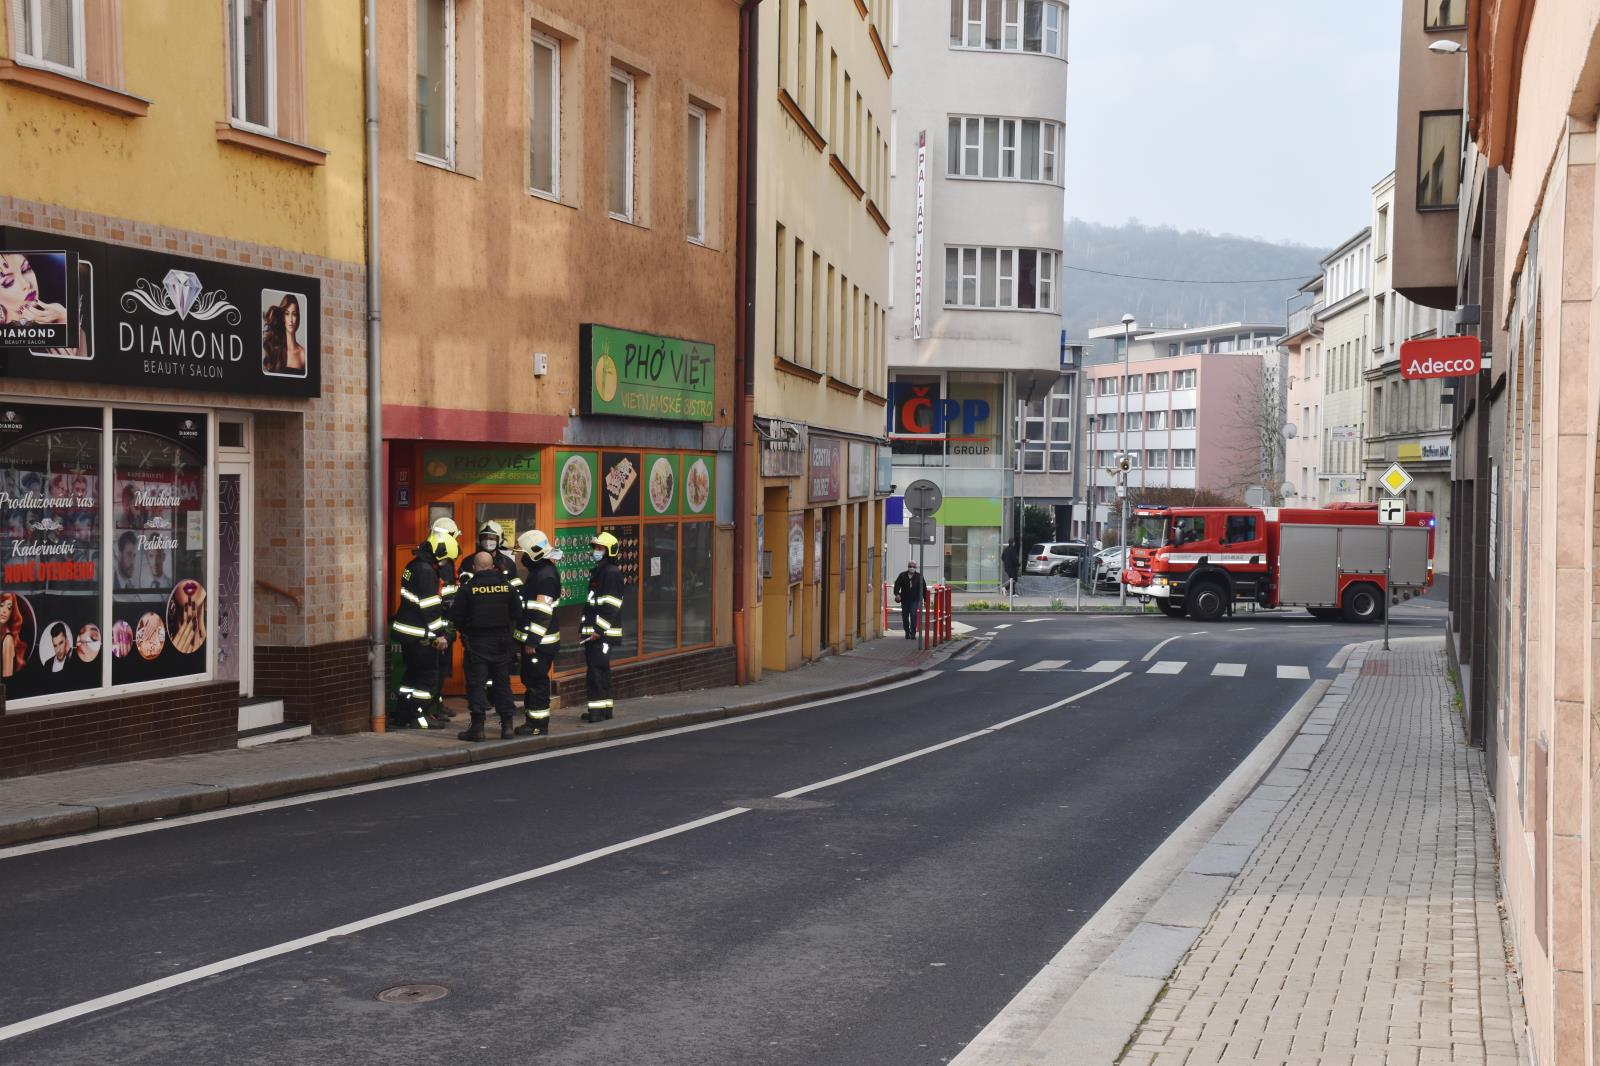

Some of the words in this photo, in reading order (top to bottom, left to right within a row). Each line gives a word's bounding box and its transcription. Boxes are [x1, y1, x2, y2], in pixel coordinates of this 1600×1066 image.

[917, 152, 925, 234] PALÁC
[914, 243, 922, 337] JORDAN
[0, 328, 55, 339] IAMOND
[119, 322, 243, 362] DIAMOND
[143, 359, 186, 376] BEAUTY
[189, 363, 224, 379] SALON
[1406, 357, 1475, 375] Adecco
[621, 391, 682, 414] VIETNAMSKÉ
[684, 399, 713, 417] BISTRO
[901, 386, 990, 435] ČPP
[953, 446, 990, 455] GROUP
[0, 490, 74, 510] Prodlužování
[11, 539, 76, 557] Kadeřnictví
[472, 585, 510, 595] POLICIE
